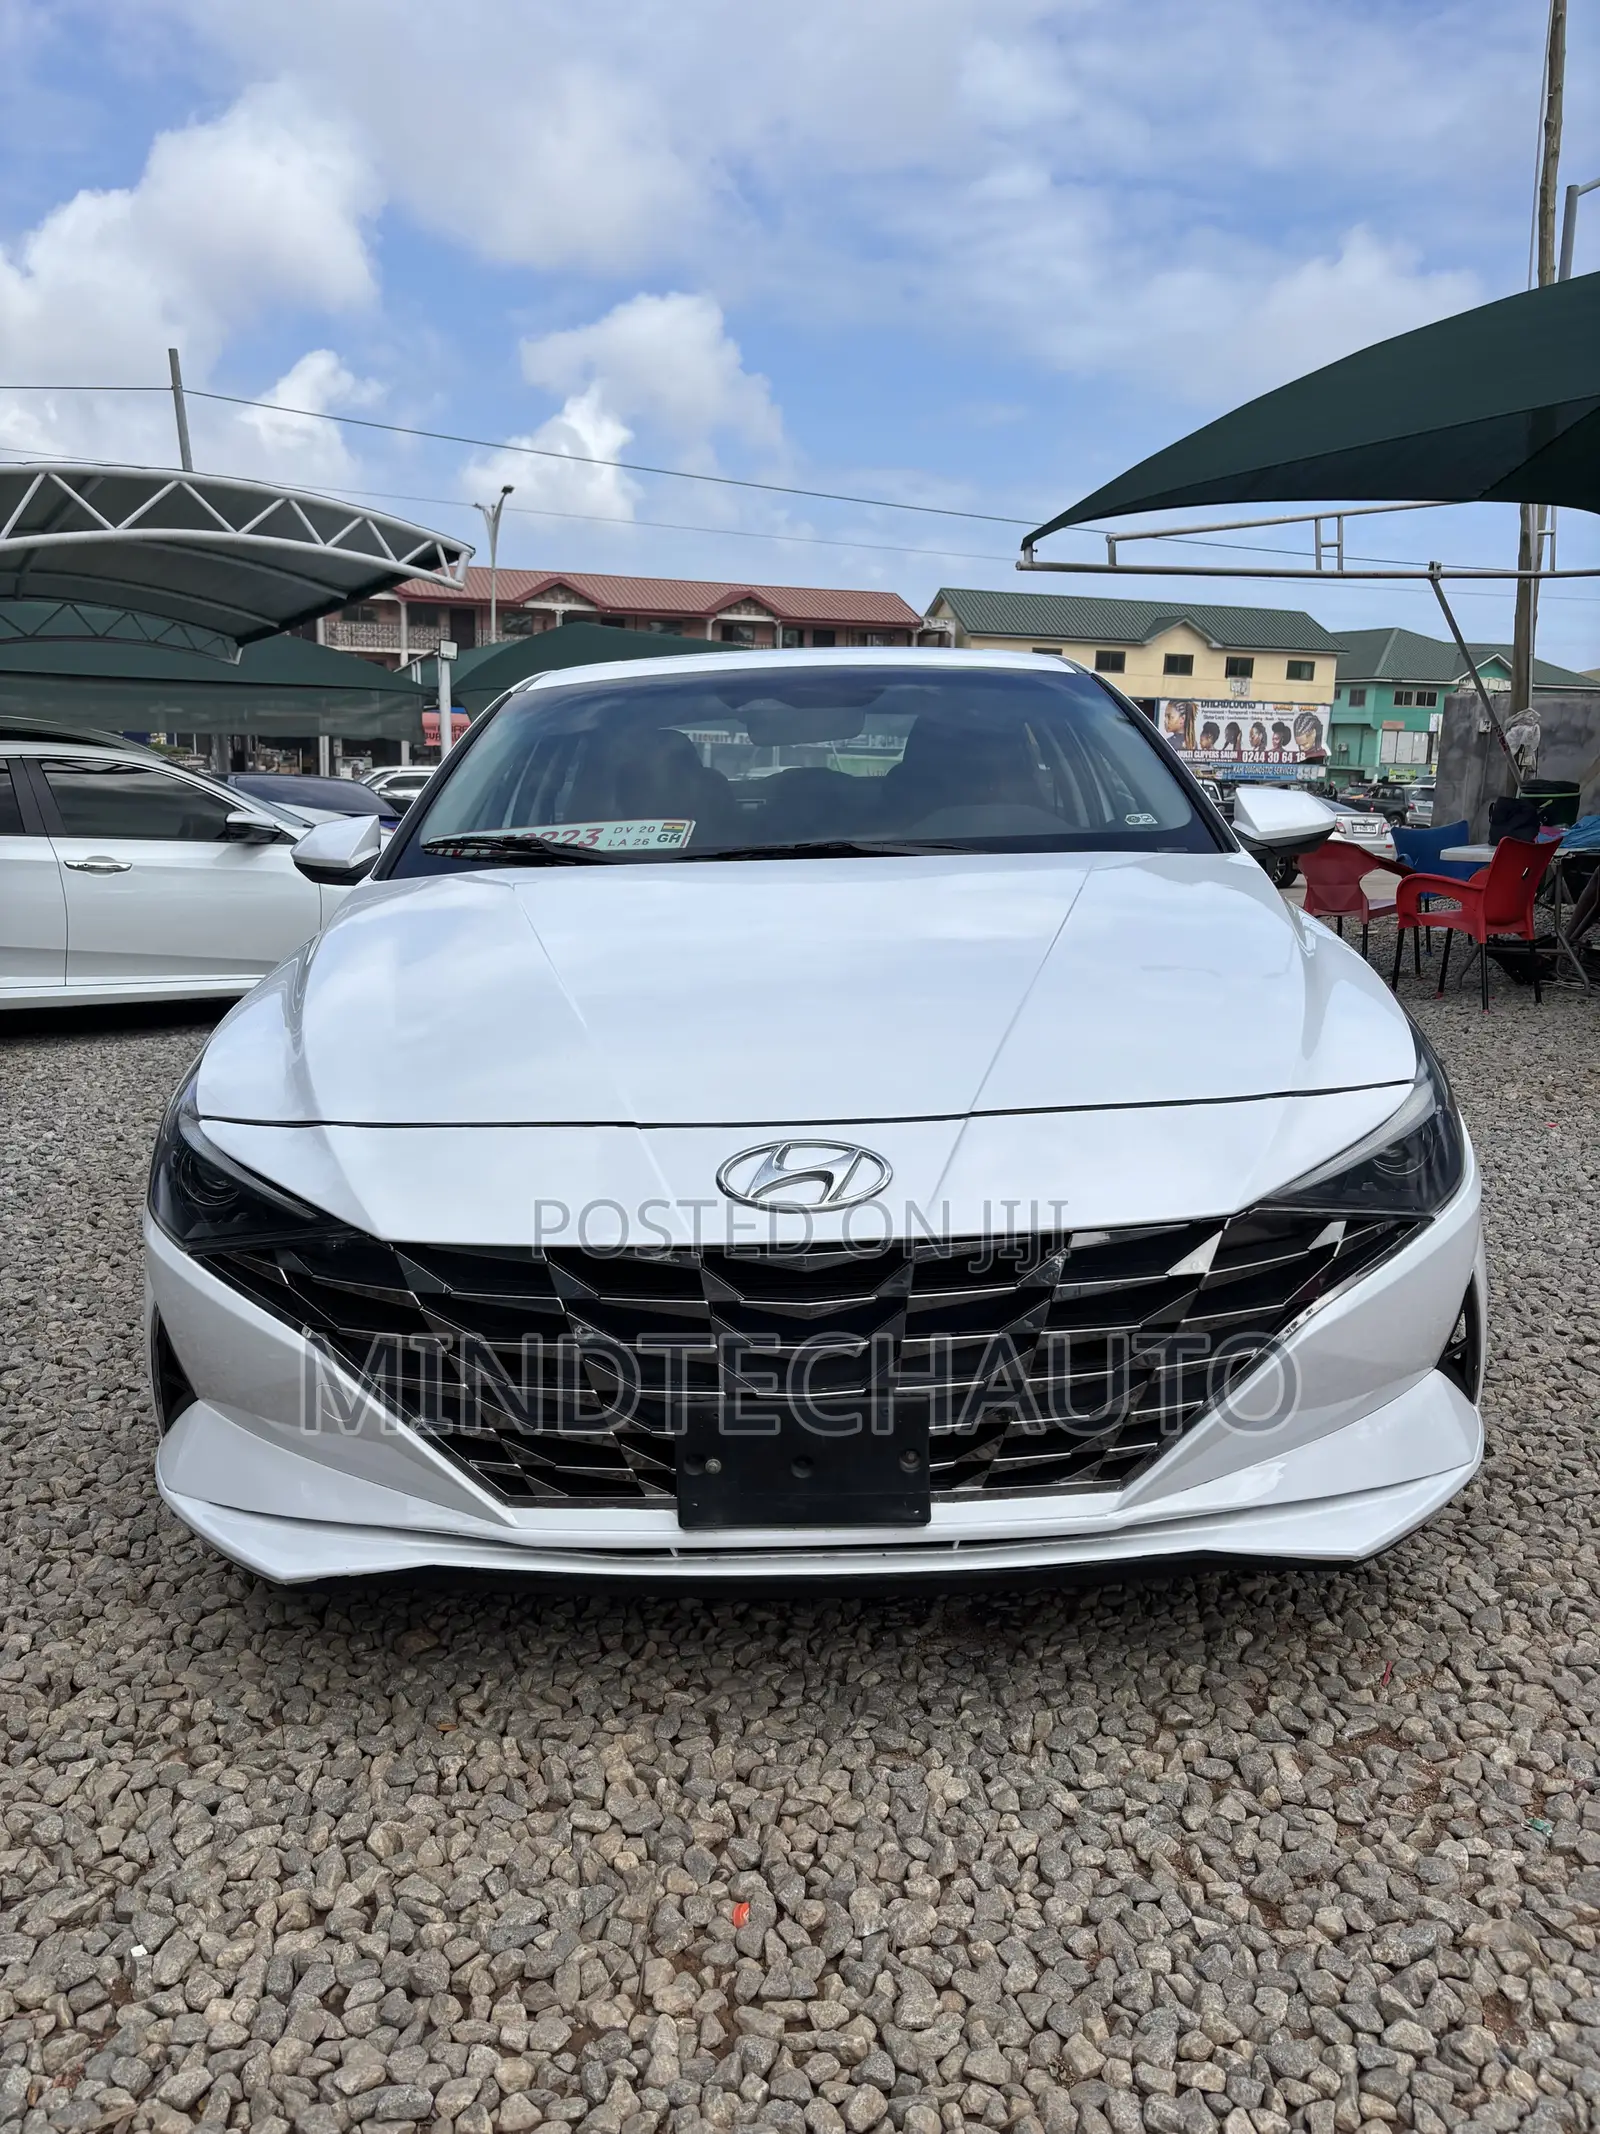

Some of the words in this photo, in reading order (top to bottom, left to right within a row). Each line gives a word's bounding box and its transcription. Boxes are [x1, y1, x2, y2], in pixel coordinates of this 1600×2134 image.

[1194, 750, 1219, 759] CLIPPERS
[1220, 750, 1238, 759] SALON
[1242, 751, 1265, 763] 0244
[1267, 751, 1280, 763] 30
[1282, 751, 1294, 763] 64
[1274, 766, 1296, 775] SERVICES
[613, 826, 634, 834] DV
[638, 825, 656, 833] 20
[607, 838, 627, 847] LA
[632, 837, 650, 846] 26
[656, 833, 683, 843] GH
